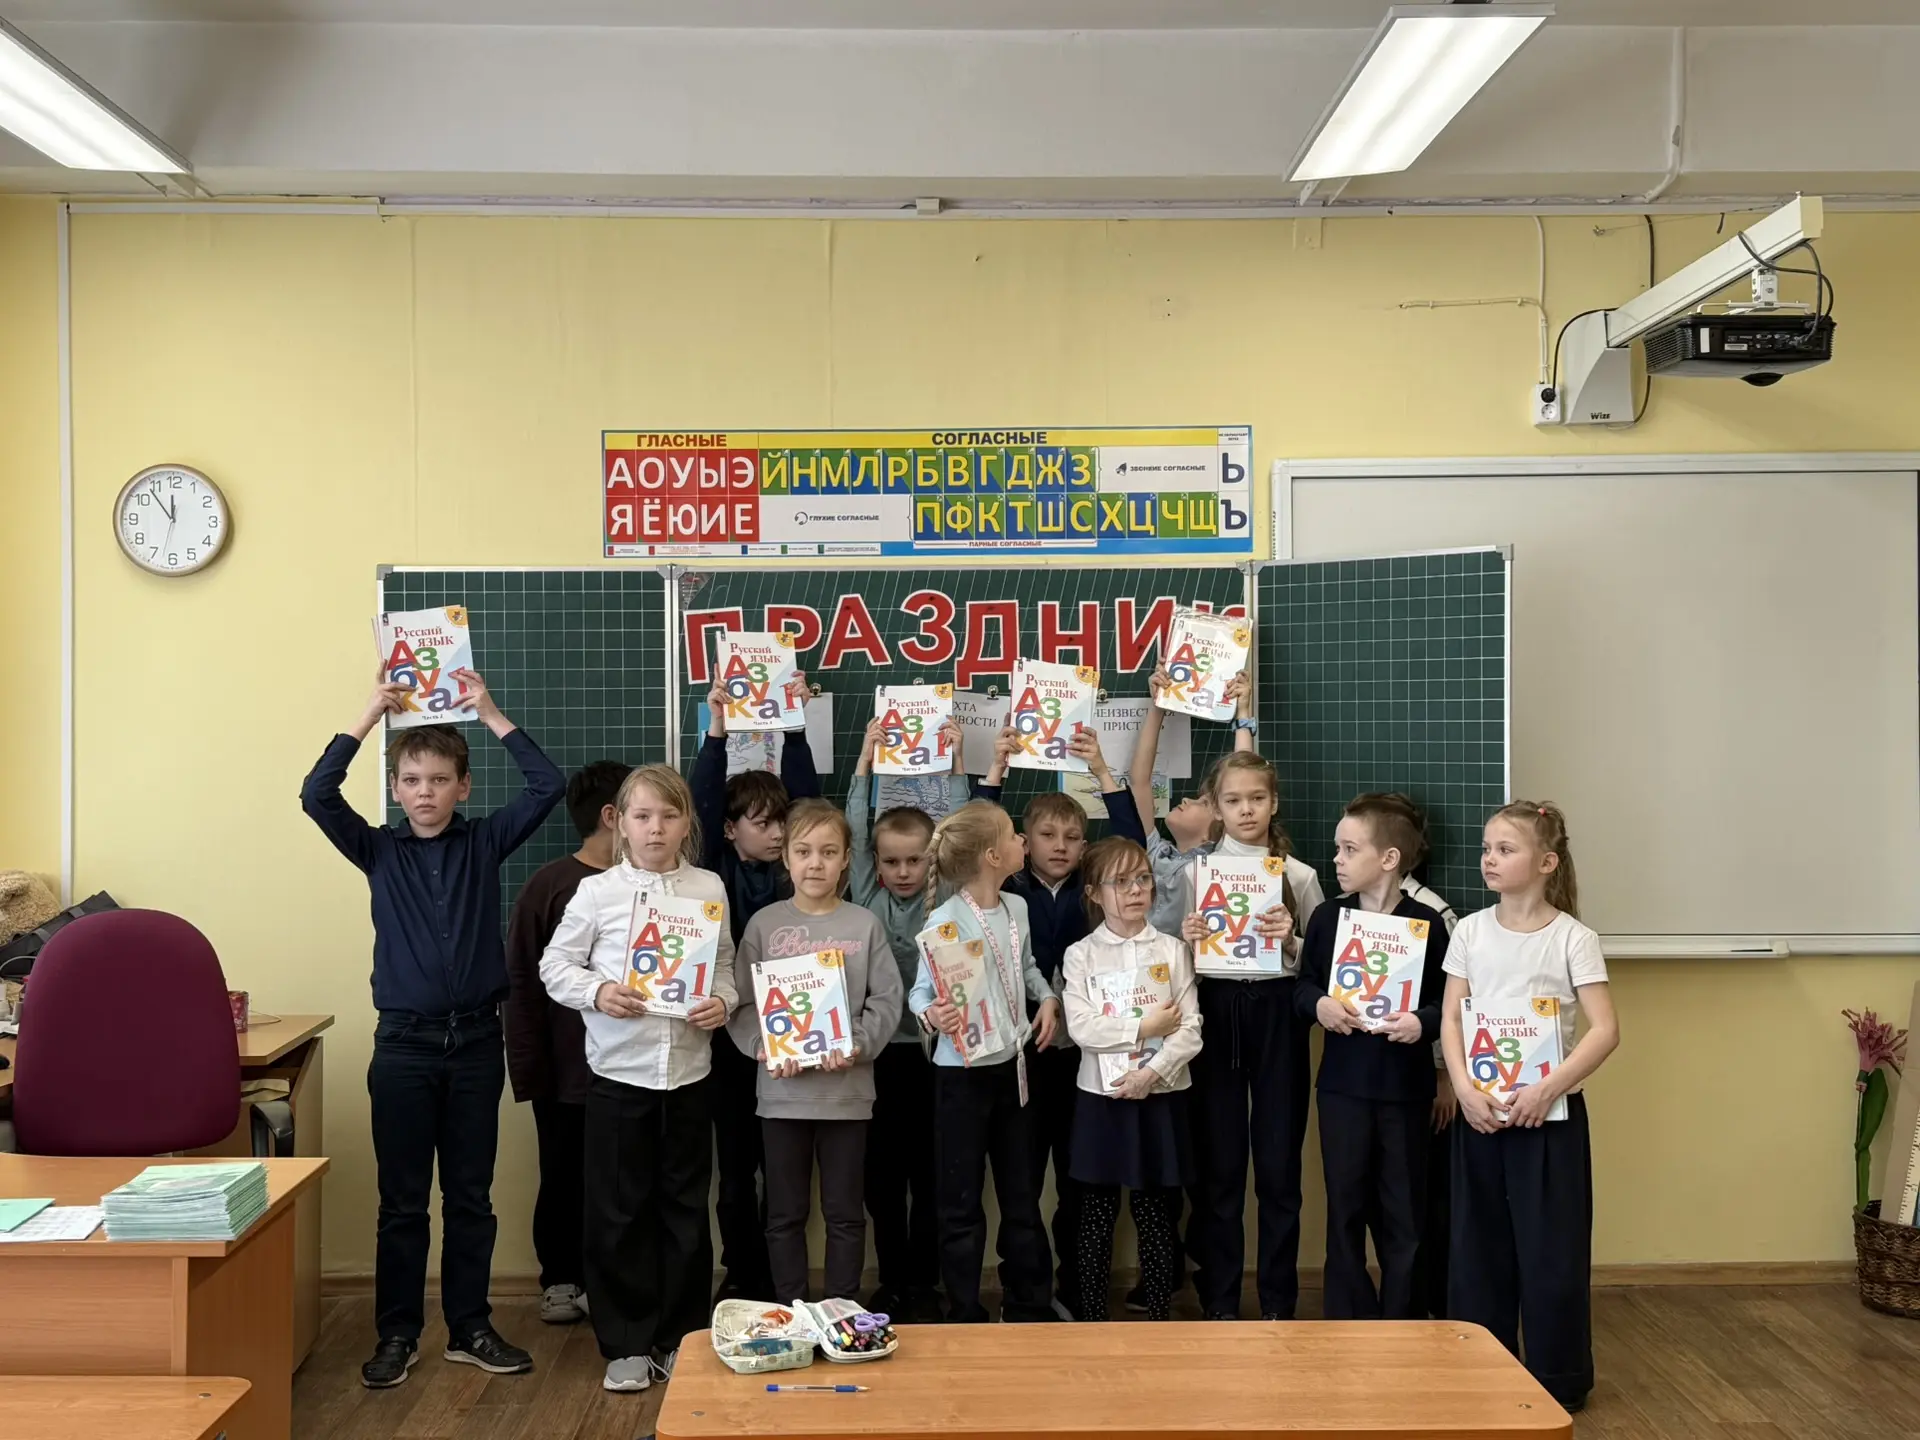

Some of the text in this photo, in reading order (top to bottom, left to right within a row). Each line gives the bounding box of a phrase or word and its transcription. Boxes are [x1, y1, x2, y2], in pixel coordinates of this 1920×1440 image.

[636, 434, 727, 448] ГЛАСНЫЕ
[931, 431, 1048, 446] СОГЛАСНЫЕ
[150, 480, 162, 493] 11
[167, 476, 182, 489] 12
[190, 481, 196, 494] 1
[135, 493, 151, 507] 10
[202, 495, 212, 508] 2
[128, 512, 139, 525] 9
[208, 515, 218, 528] 3
[134, 532, 145, 545] 8
[202, 534, 212, 547] 4
[149, 546, 159, 559] 7
[168, 552, 178, 566] 6
[186, 547, 197, 560] 5
[393, 625, 443, 639] Русский
[417, 636, 455, 648] язык
[683, 589, 1248, 690] ПРАЗДНИ
[729, 642, 772, 654] Русский
[750, 655, 782, 664] язык
[1025, 673, 1069, 688] Русский
[1045, 688, 1078, 699] язык
[888, 698, 930, 709] Русский
[907, 706, 939, 715] язык
[1210, 868, 1257, 883] Русский
[1231, 883, 1267, 894] язык
[648, 907, 695, 926] Русский
[667, 924, 704, 938] язык
[1351, 923, 1400, 942] Русский
[1372, 940, 1409, 955] язык
[689, 962, 708, 997] 1
[767, 970, 814, 987] Русский
[790, 978, 826, 992] язык
[1395, 979, 1413, 1013] 1
[824, 1006, 847, 1041] 1
[1476, 1012, 1526, 1028] Русский
[1499, 1027, 1539, 1037] язык
